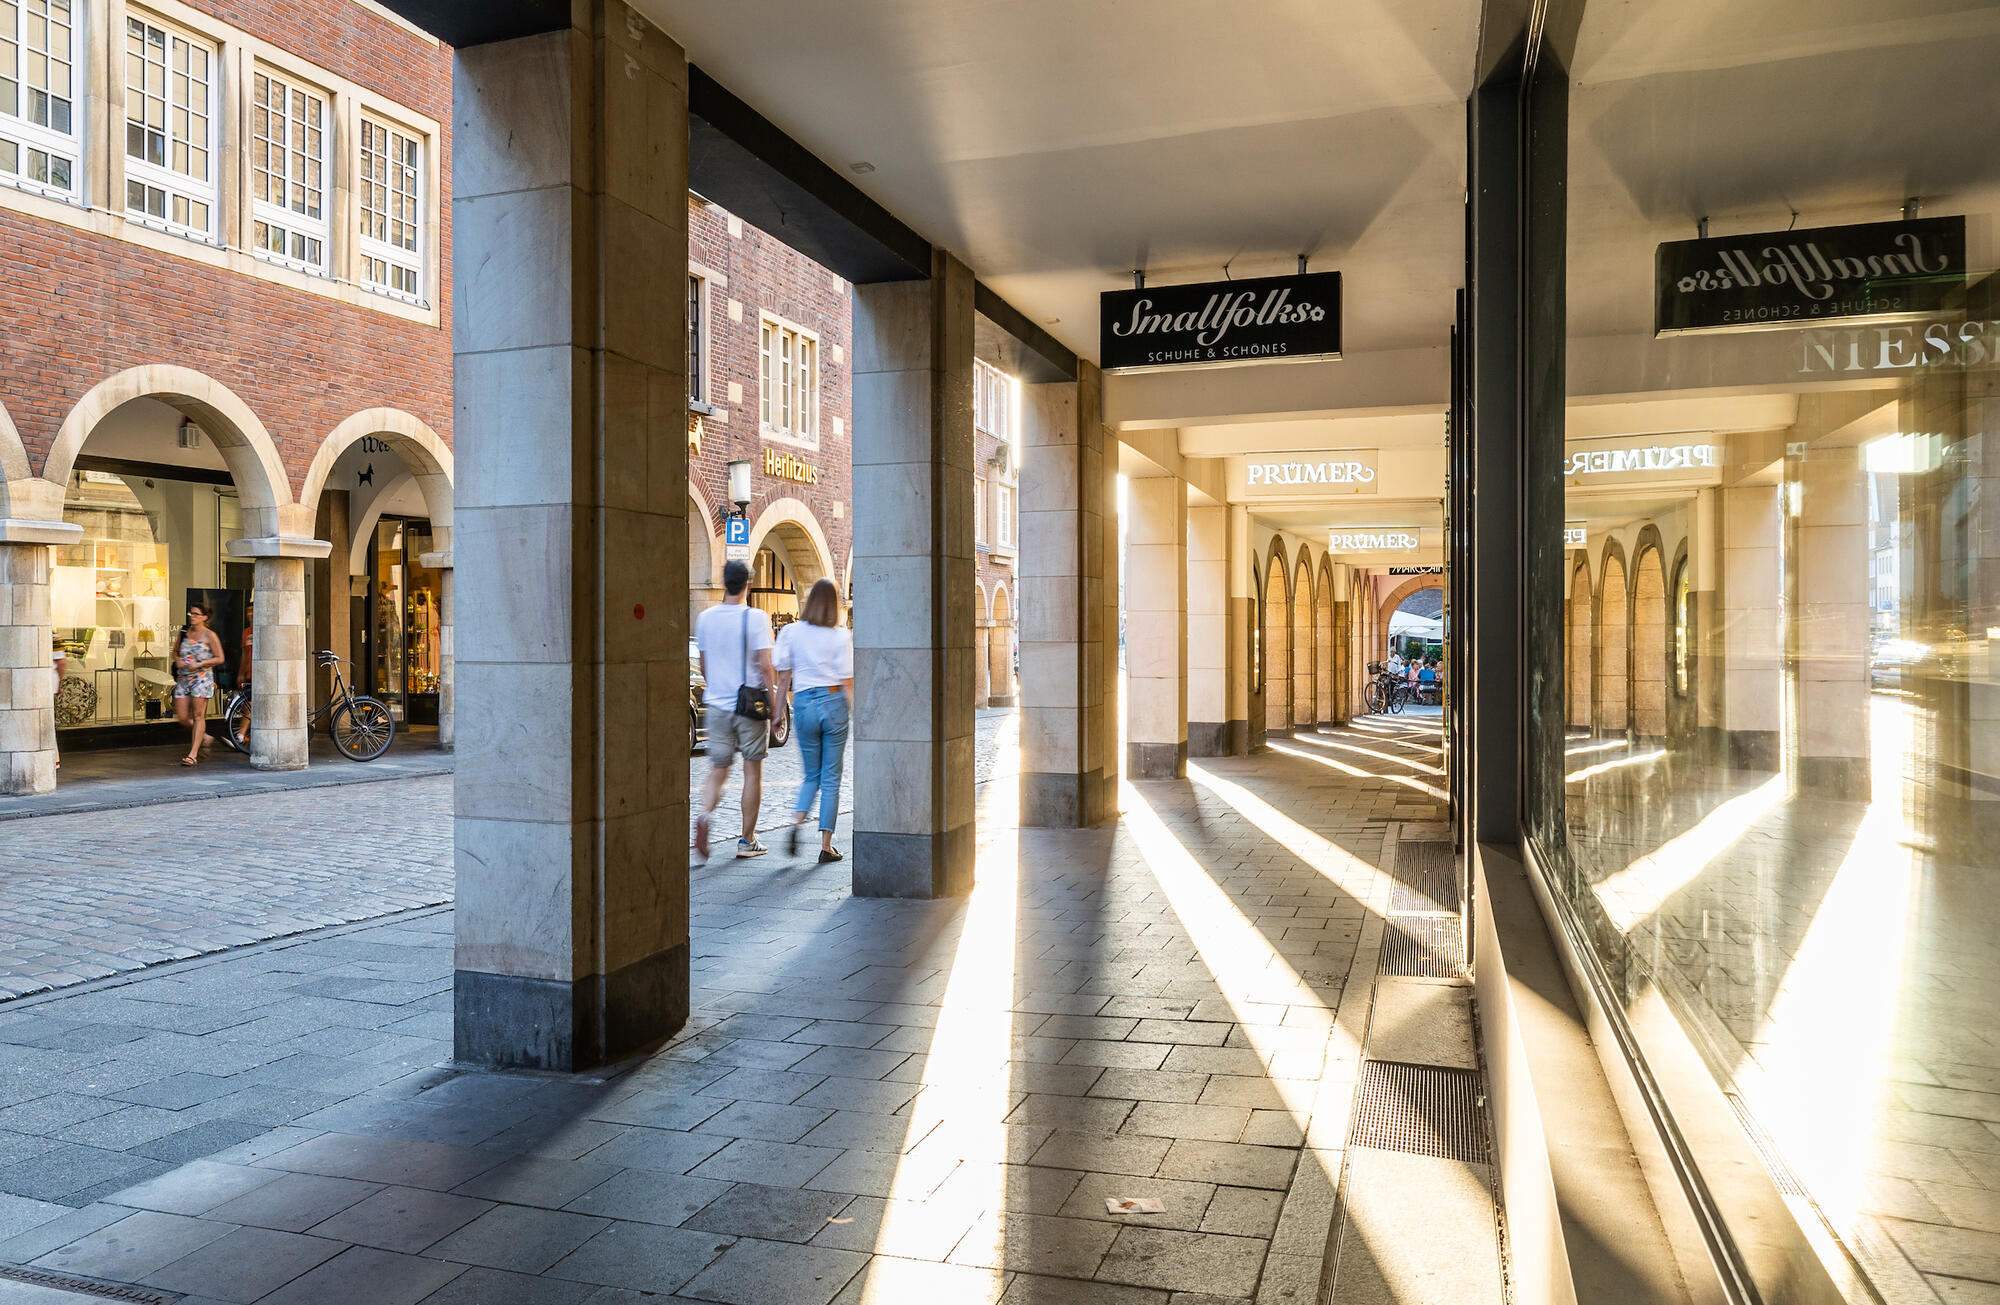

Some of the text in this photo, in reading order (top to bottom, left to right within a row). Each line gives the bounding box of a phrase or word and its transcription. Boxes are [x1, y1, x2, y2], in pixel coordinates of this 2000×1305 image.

[1112, 288, 1312, 346] Smallfolks
[1148, 342, 1287, 362] SCHUHE & SCHÖNES
[765, 448, 818, 485] Herlitzius
[1247, 462, 1375, 485] PRÜMER
[731, 521, 744, 541] P
[1330, 533, 1418, 549] PRÜMER
